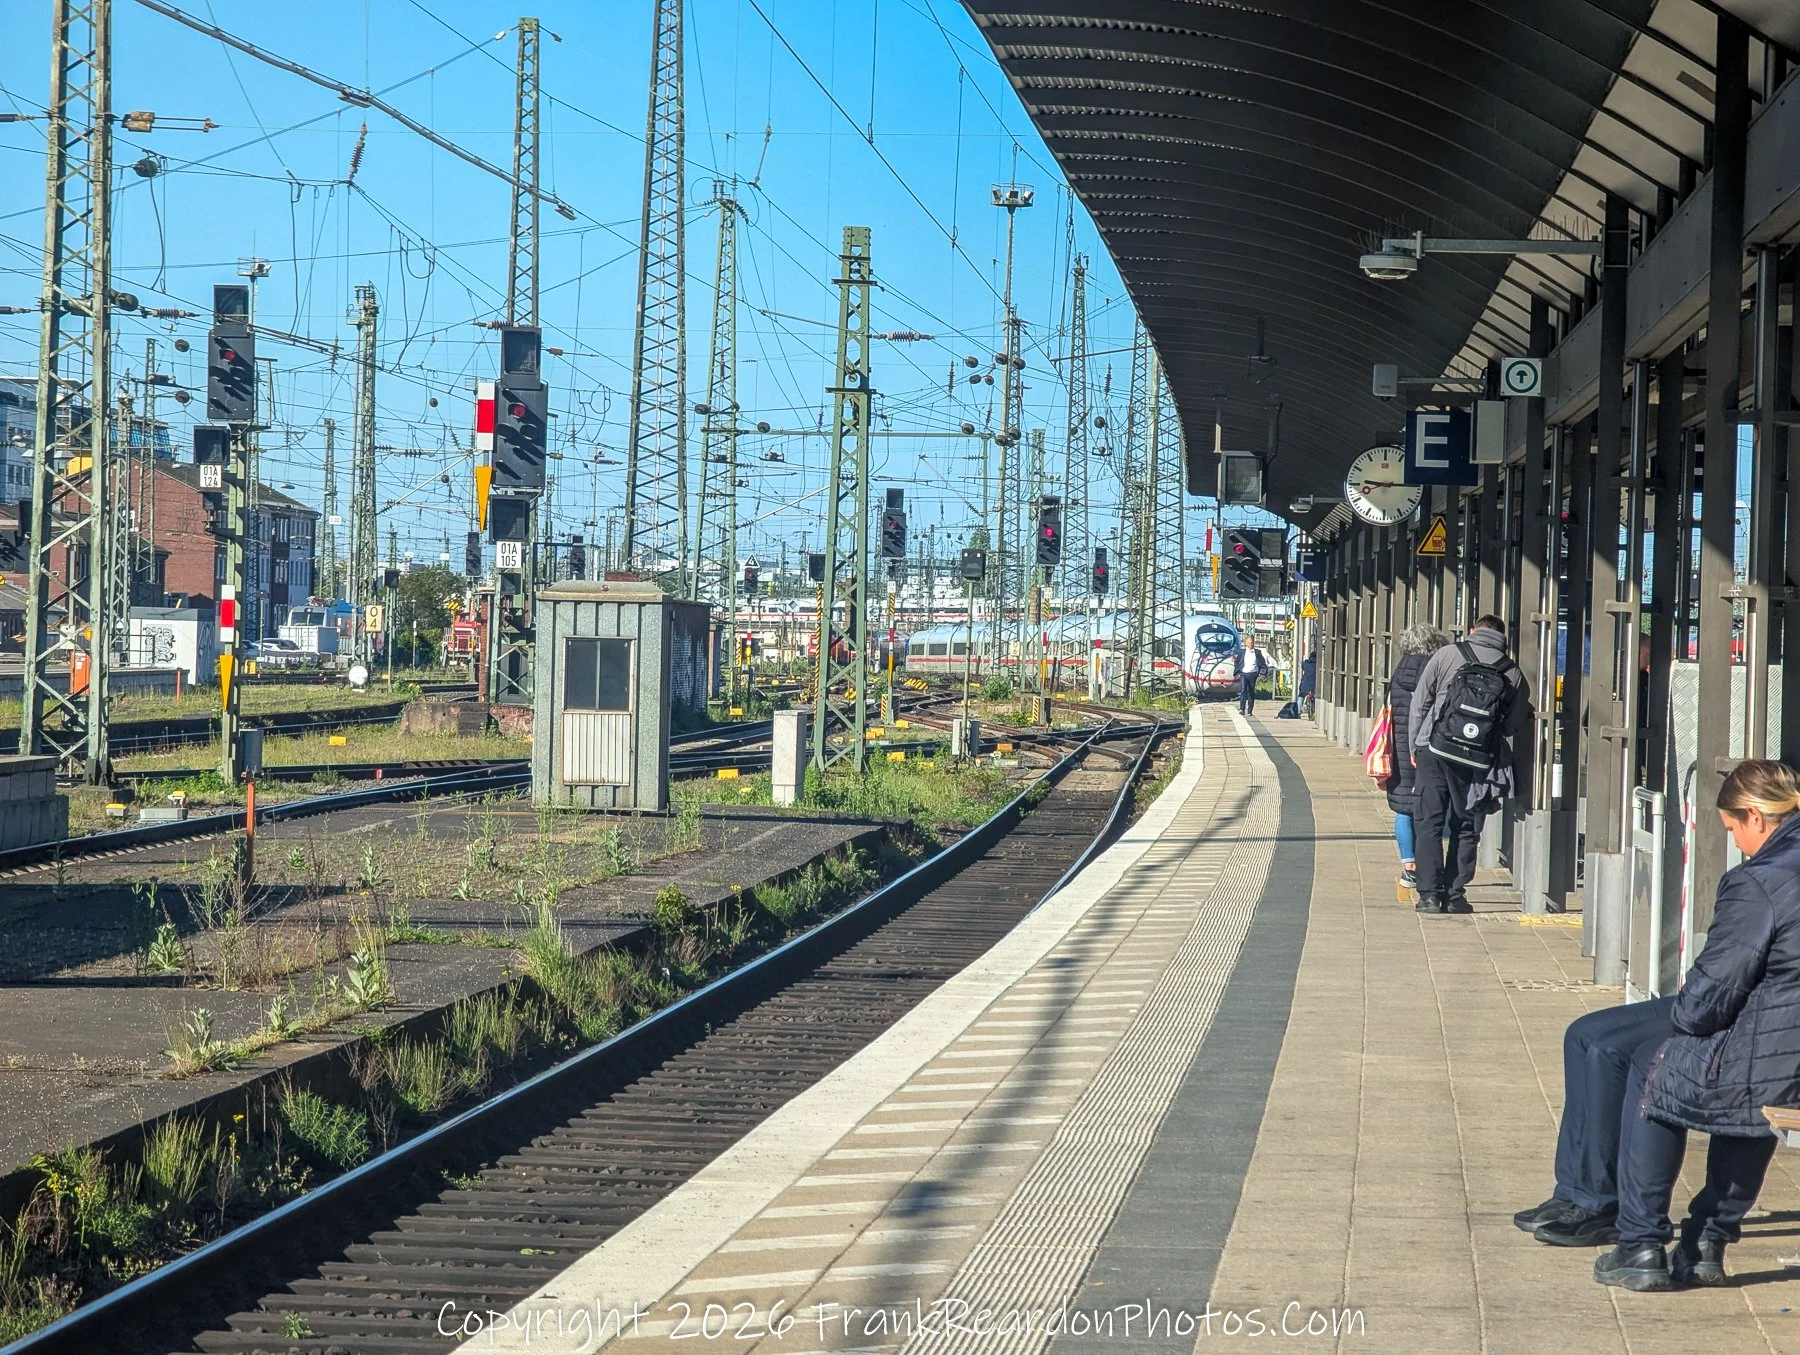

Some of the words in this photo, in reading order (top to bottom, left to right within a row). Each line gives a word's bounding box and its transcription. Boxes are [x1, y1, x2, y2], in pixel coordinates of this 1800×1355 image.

[1415, 414, 1450, 468] E
[203, 465, 218, 476] 01A
[203, 477, 218, 487] 124
[501, 542, 517, 555] 01A
[501, 555, 517, 567] 105
[1300, 552, 1314, 574] F
[370, 606, 378, 617] 0
[370, 618, 377, 629] 4
